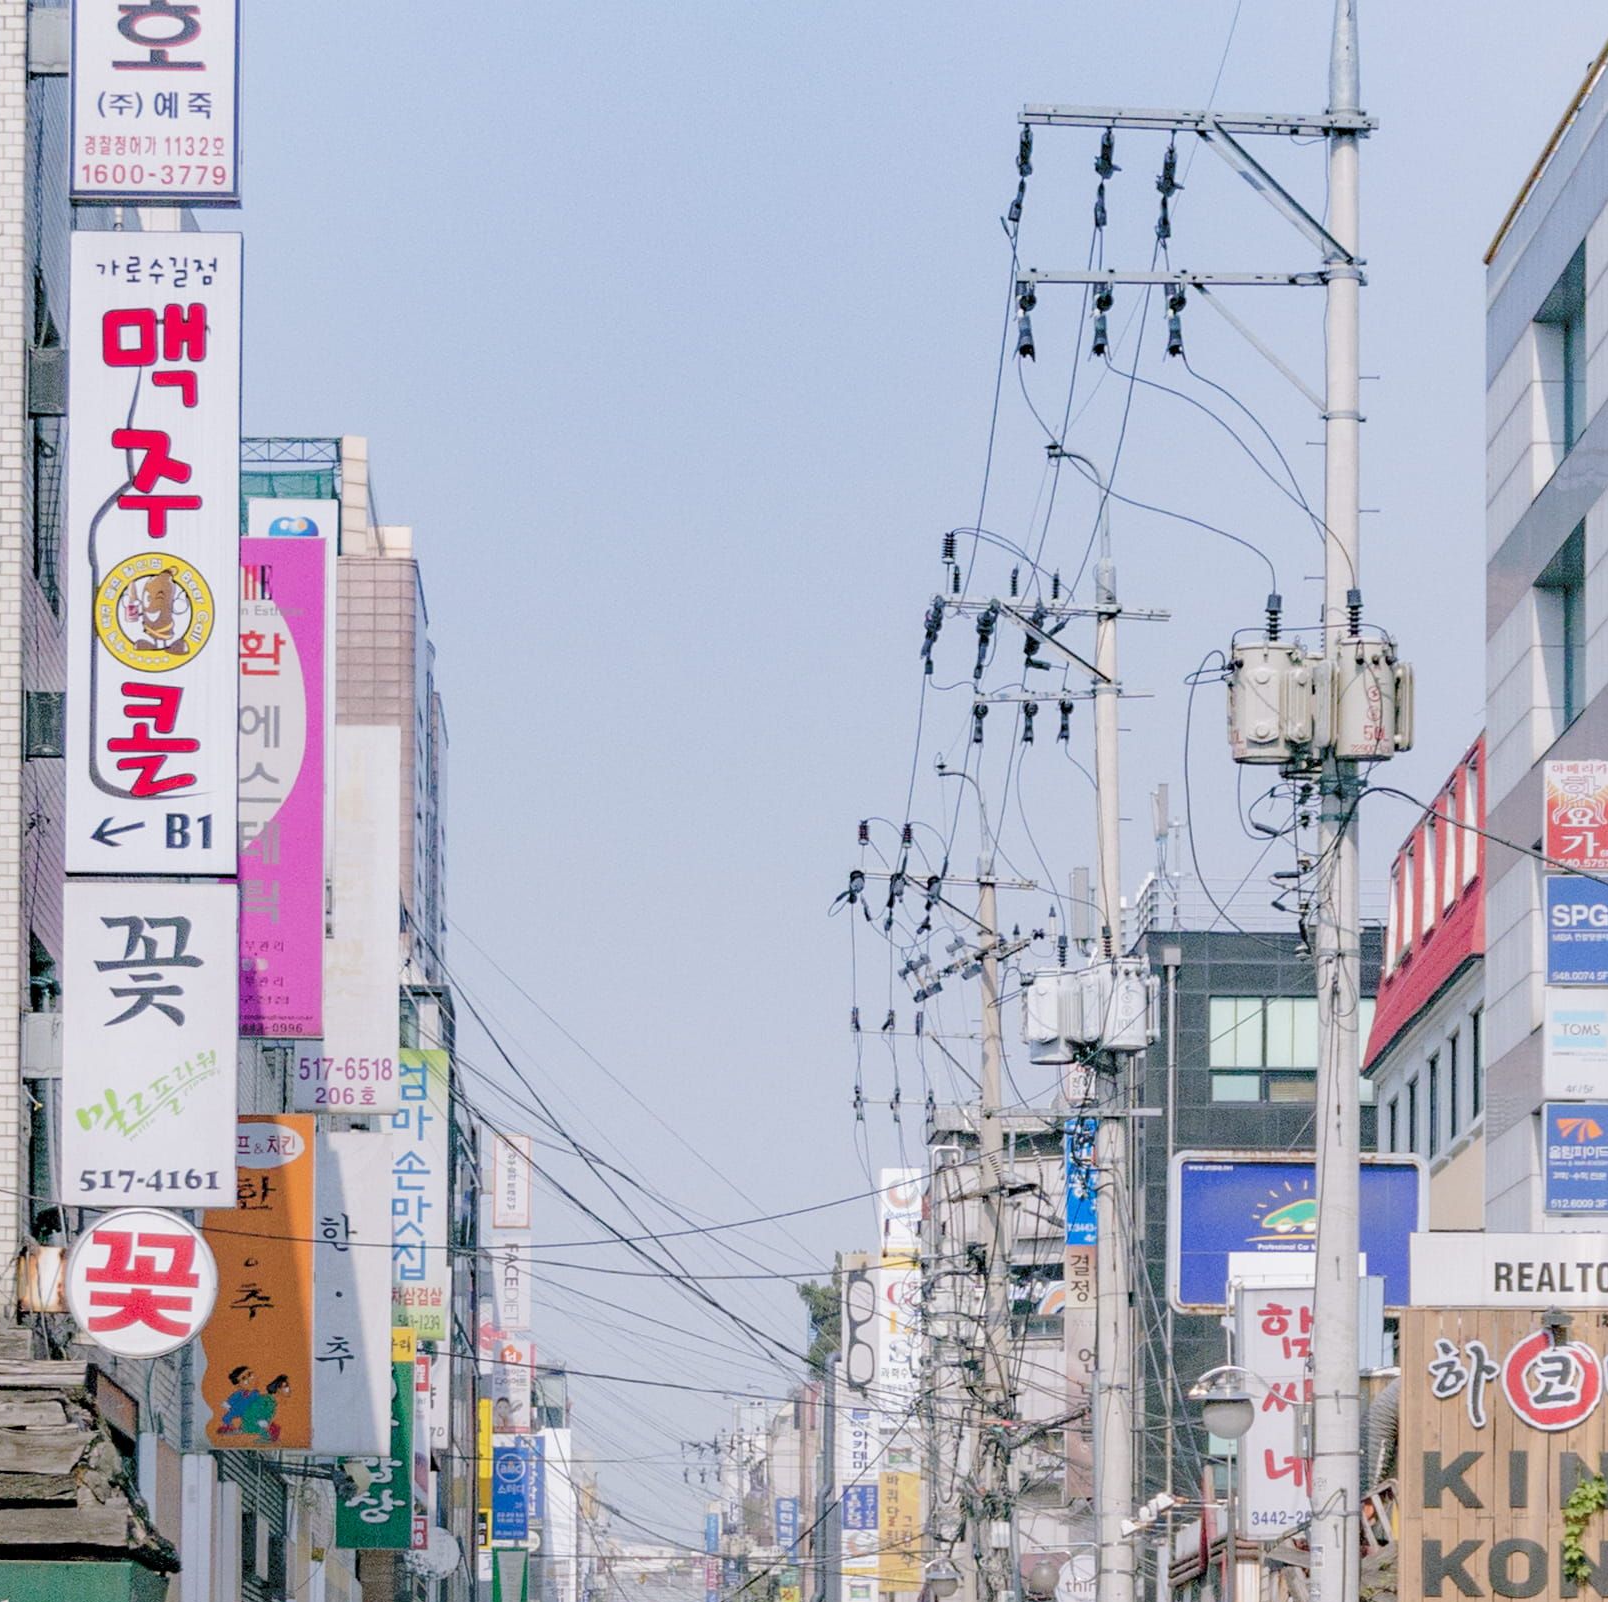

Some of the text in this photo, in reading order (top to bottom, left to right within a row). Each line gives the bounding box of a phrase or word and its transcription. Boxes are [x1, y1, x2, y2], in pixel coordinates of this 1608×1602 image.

[97, 92, 143, 119] (주)
[80, 164, 227, 187] 1600-3779
[96, 256, 218, 288] 가로수길점
[1552, 763, 1608, 775] 아메리카
[165, 814, 213, 850] B1
[95, 915, 204, 1027] 꽃
[1561, 1023, 1601, 1036] TOMS
[298, 1057, 393, 1081] 517-6518
[266, 1135, 295, 1156] 치킨
[79, 1168, 222, 1192] 517-4161
[86, 1230, 200, 1338] 꽃
